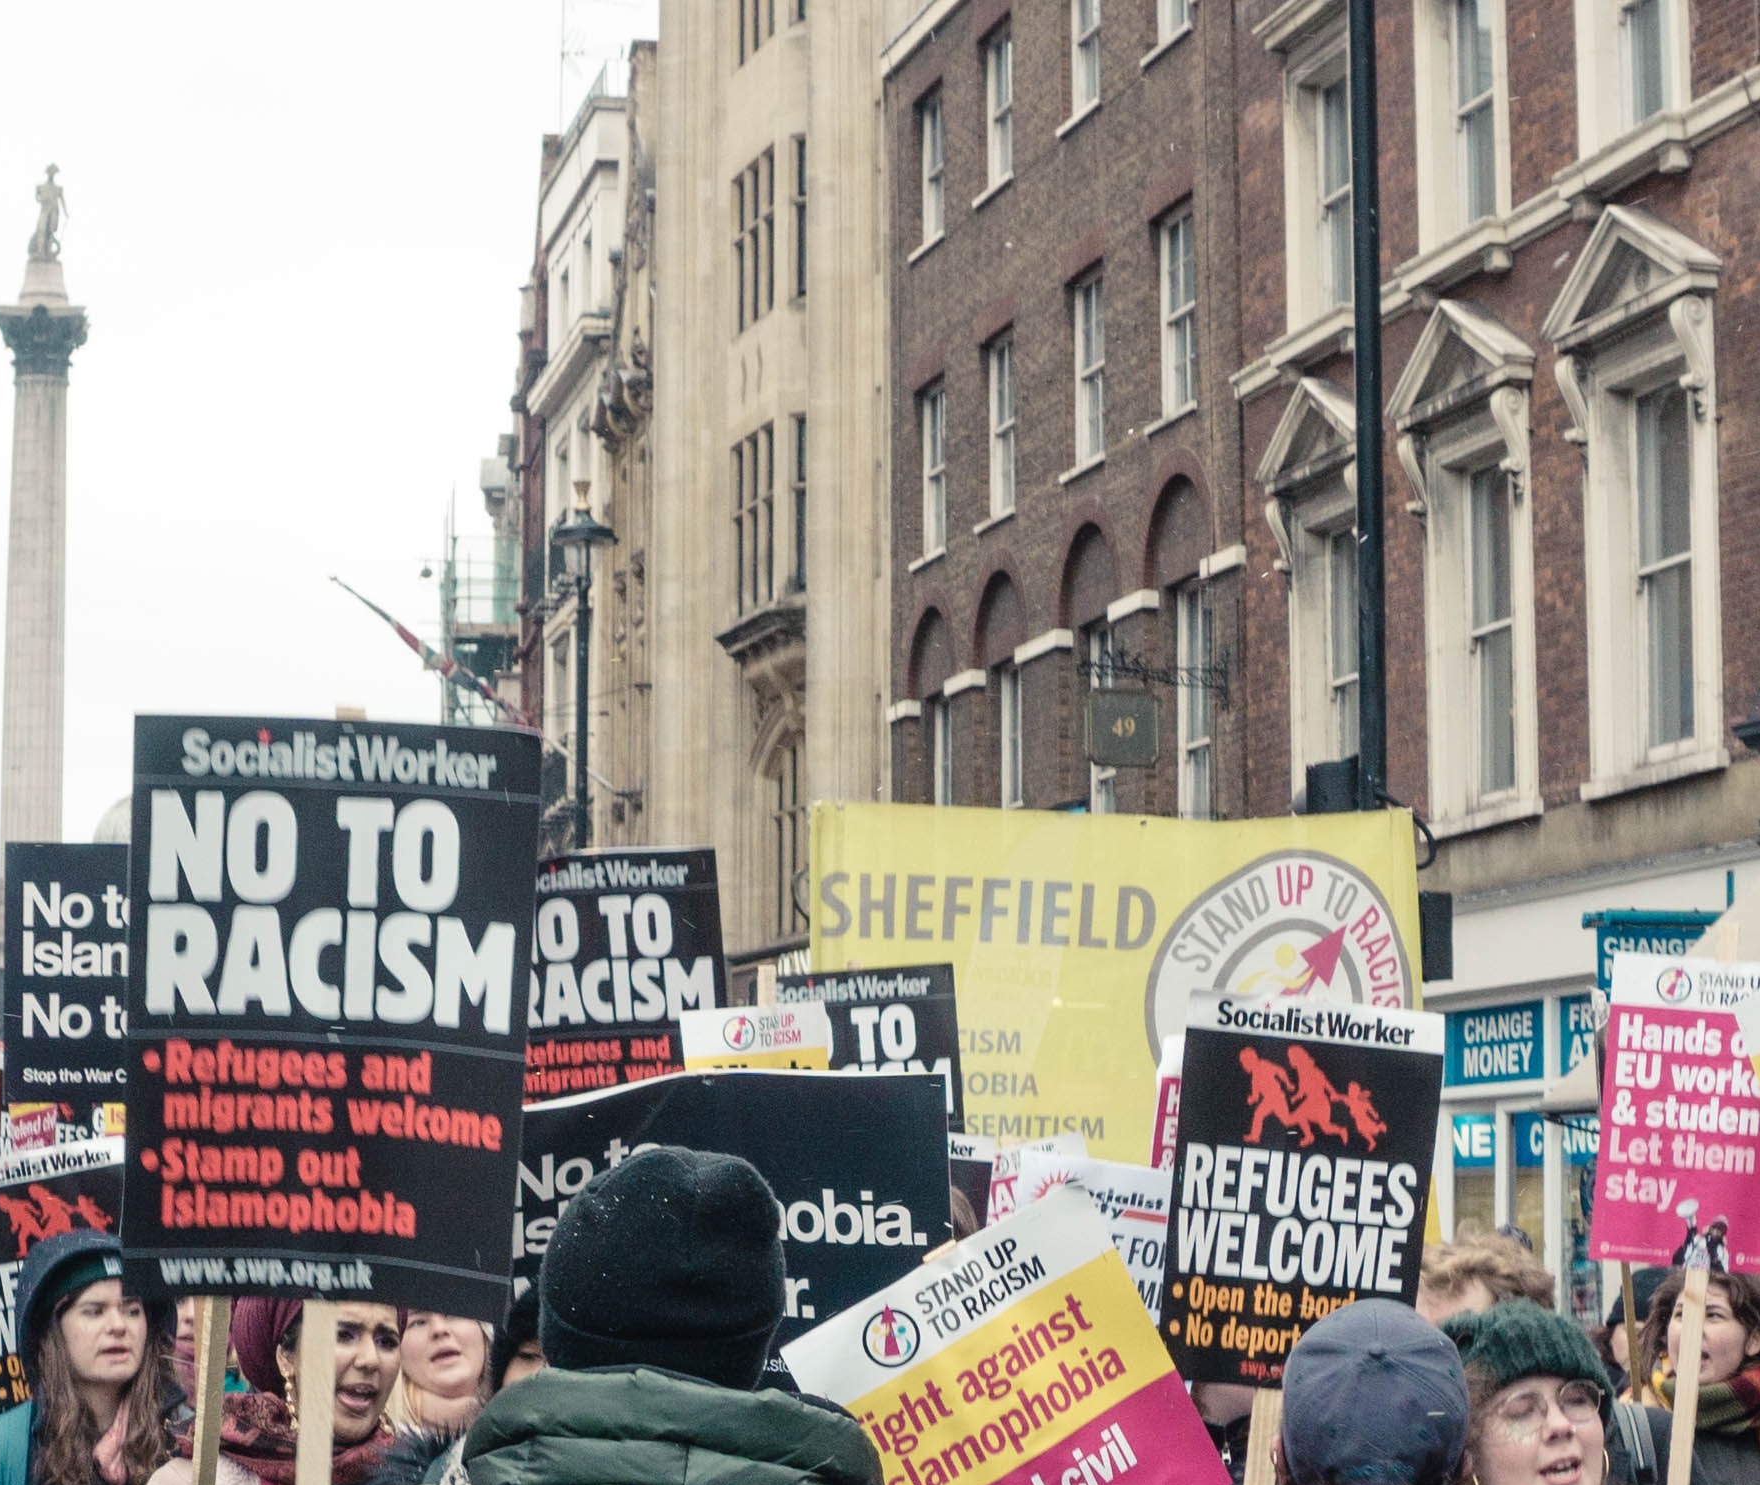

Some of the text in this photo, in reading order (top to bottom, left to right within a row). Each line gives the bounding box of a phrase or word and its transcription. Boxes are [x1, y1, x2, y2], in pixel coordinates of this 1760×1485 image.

[1112, 716, 1136, 737] 49
[148, 788, 461, 914] NO TO
[22, 881, 94, 930] No
[598, 893, 674, 958] TO
[819, 872, 1156, 952] SHEFFIELD
[1171, 864, 1401, 1009] STAND UP TO RACIS
[145, 903, 516, 1036] RACISM
[22, 992, 94, 1039] No
[849, 1004, 917, 1063] TO
[1463, 1011, 1533, 1044] CHANGE
[1617, 1013, 1723, 1056] Hands
[22, 1067, 54, 1089] Stop
[58, 1067, 81, 1084] the
[83, 1067, 112, 1084] War
[164, 1038, 433, 1096] Refugees and
[1463, 1042, 1533, 1078] MONEY
[1615, 1051, 1661, 1090] EU
[163, 1084, 335, 1134] migrants
[348, 1096, 503, 1152] welcome
[1611, 1090, 1637, 1126] &
[160, 1137, 362, 1188] Stamp out
[1609, 1128, 1663, 1166] Let
[1671, 1134, 1756, 1175] them
[159, 1182, 417, 1239] Islamophobia
[1181, 1143, 1418, 1228] REFUGEES
[1605, 1169, 1678, 1213] stay
[159, 1257, 374, 1291] www.swp.org.uk
[914, 1237, 1018, 1314] STAND UP
[1177, 1207, 1409, 1293] WELCOME
[927, 1310, 962, 1338] TO
[963, 1254, 1046, 1322] RACISM
[1188, 1275, 1292, 1318] Open the
[955, 1292, 1094, 1400] against
[1185, 1312, 1214, 1347] No
